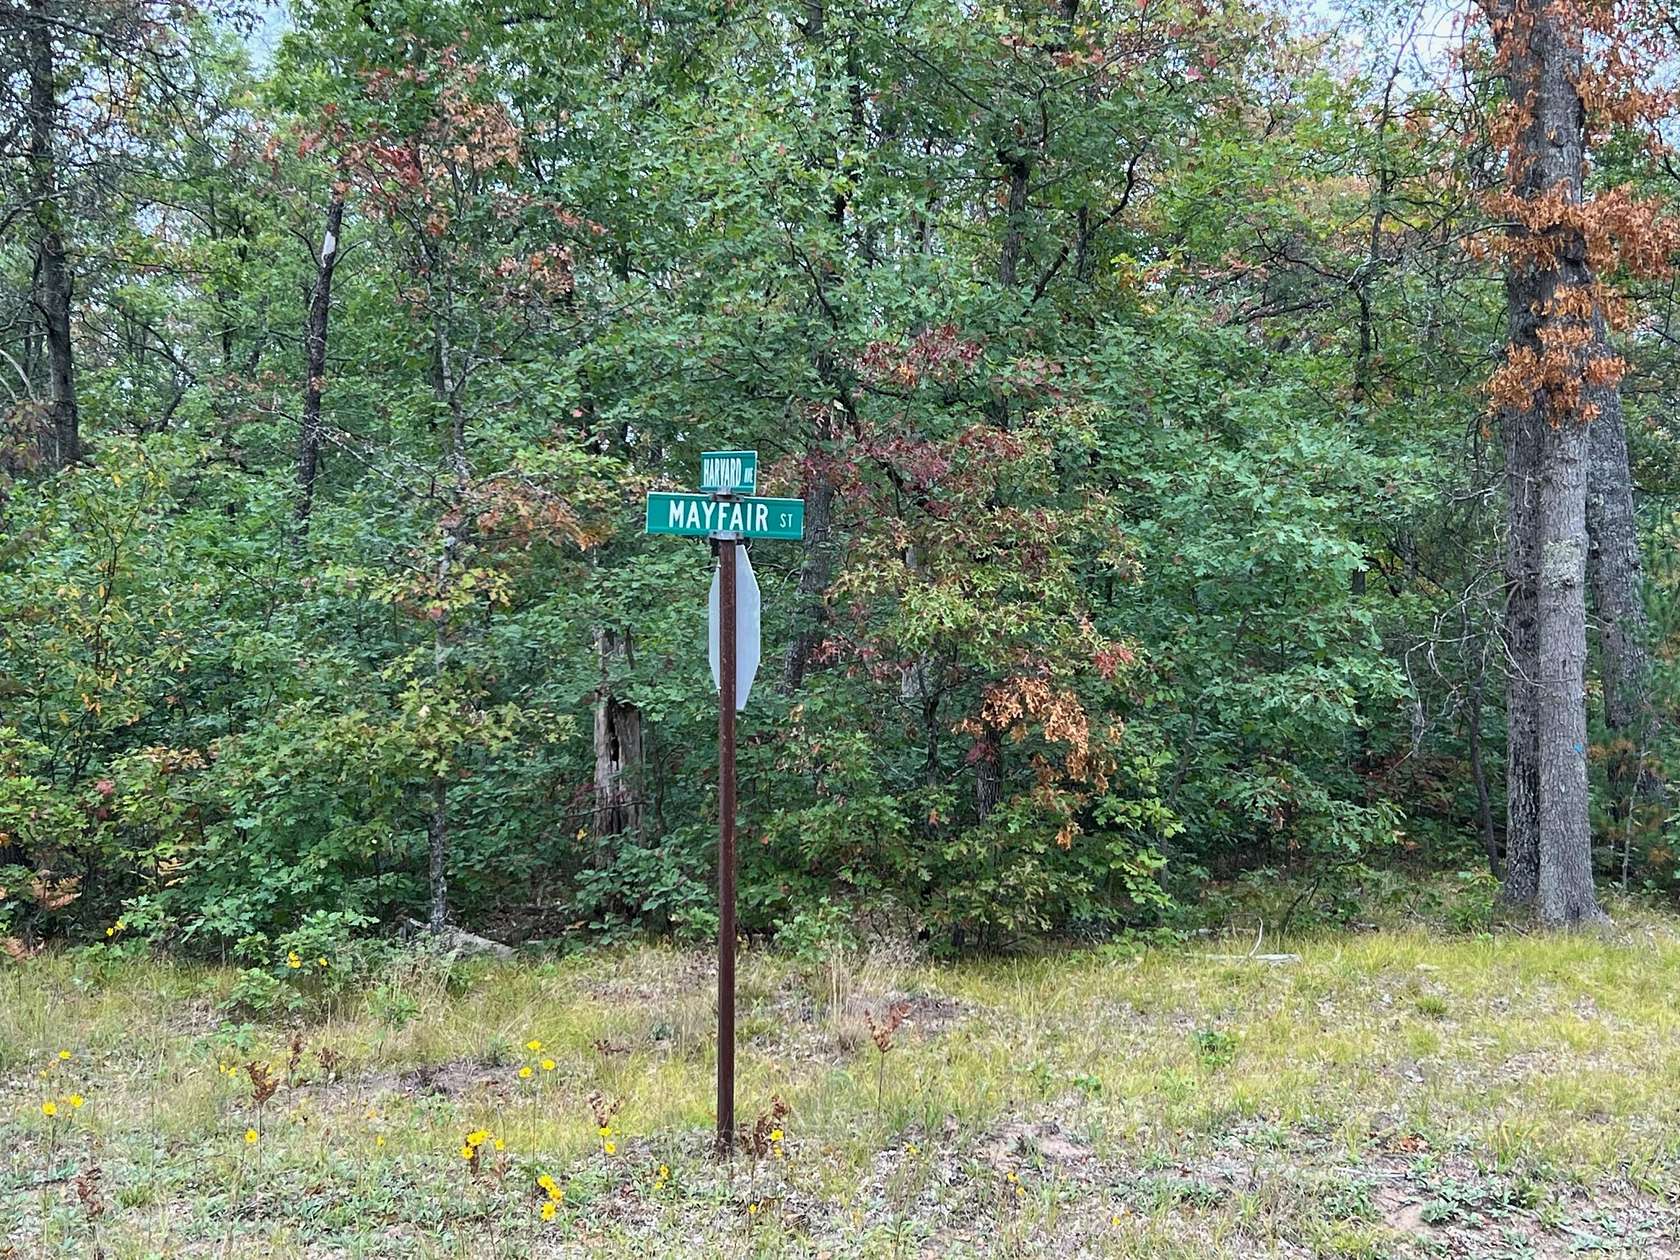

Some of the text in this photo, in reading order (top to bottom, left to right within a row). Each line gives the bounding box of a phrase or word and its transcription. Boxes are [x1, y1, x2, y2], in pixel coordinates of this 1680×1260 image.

[703, 458, 754, 487] HARVARD AVE
[668, 500, 793, 531] MAYFAIR ST
